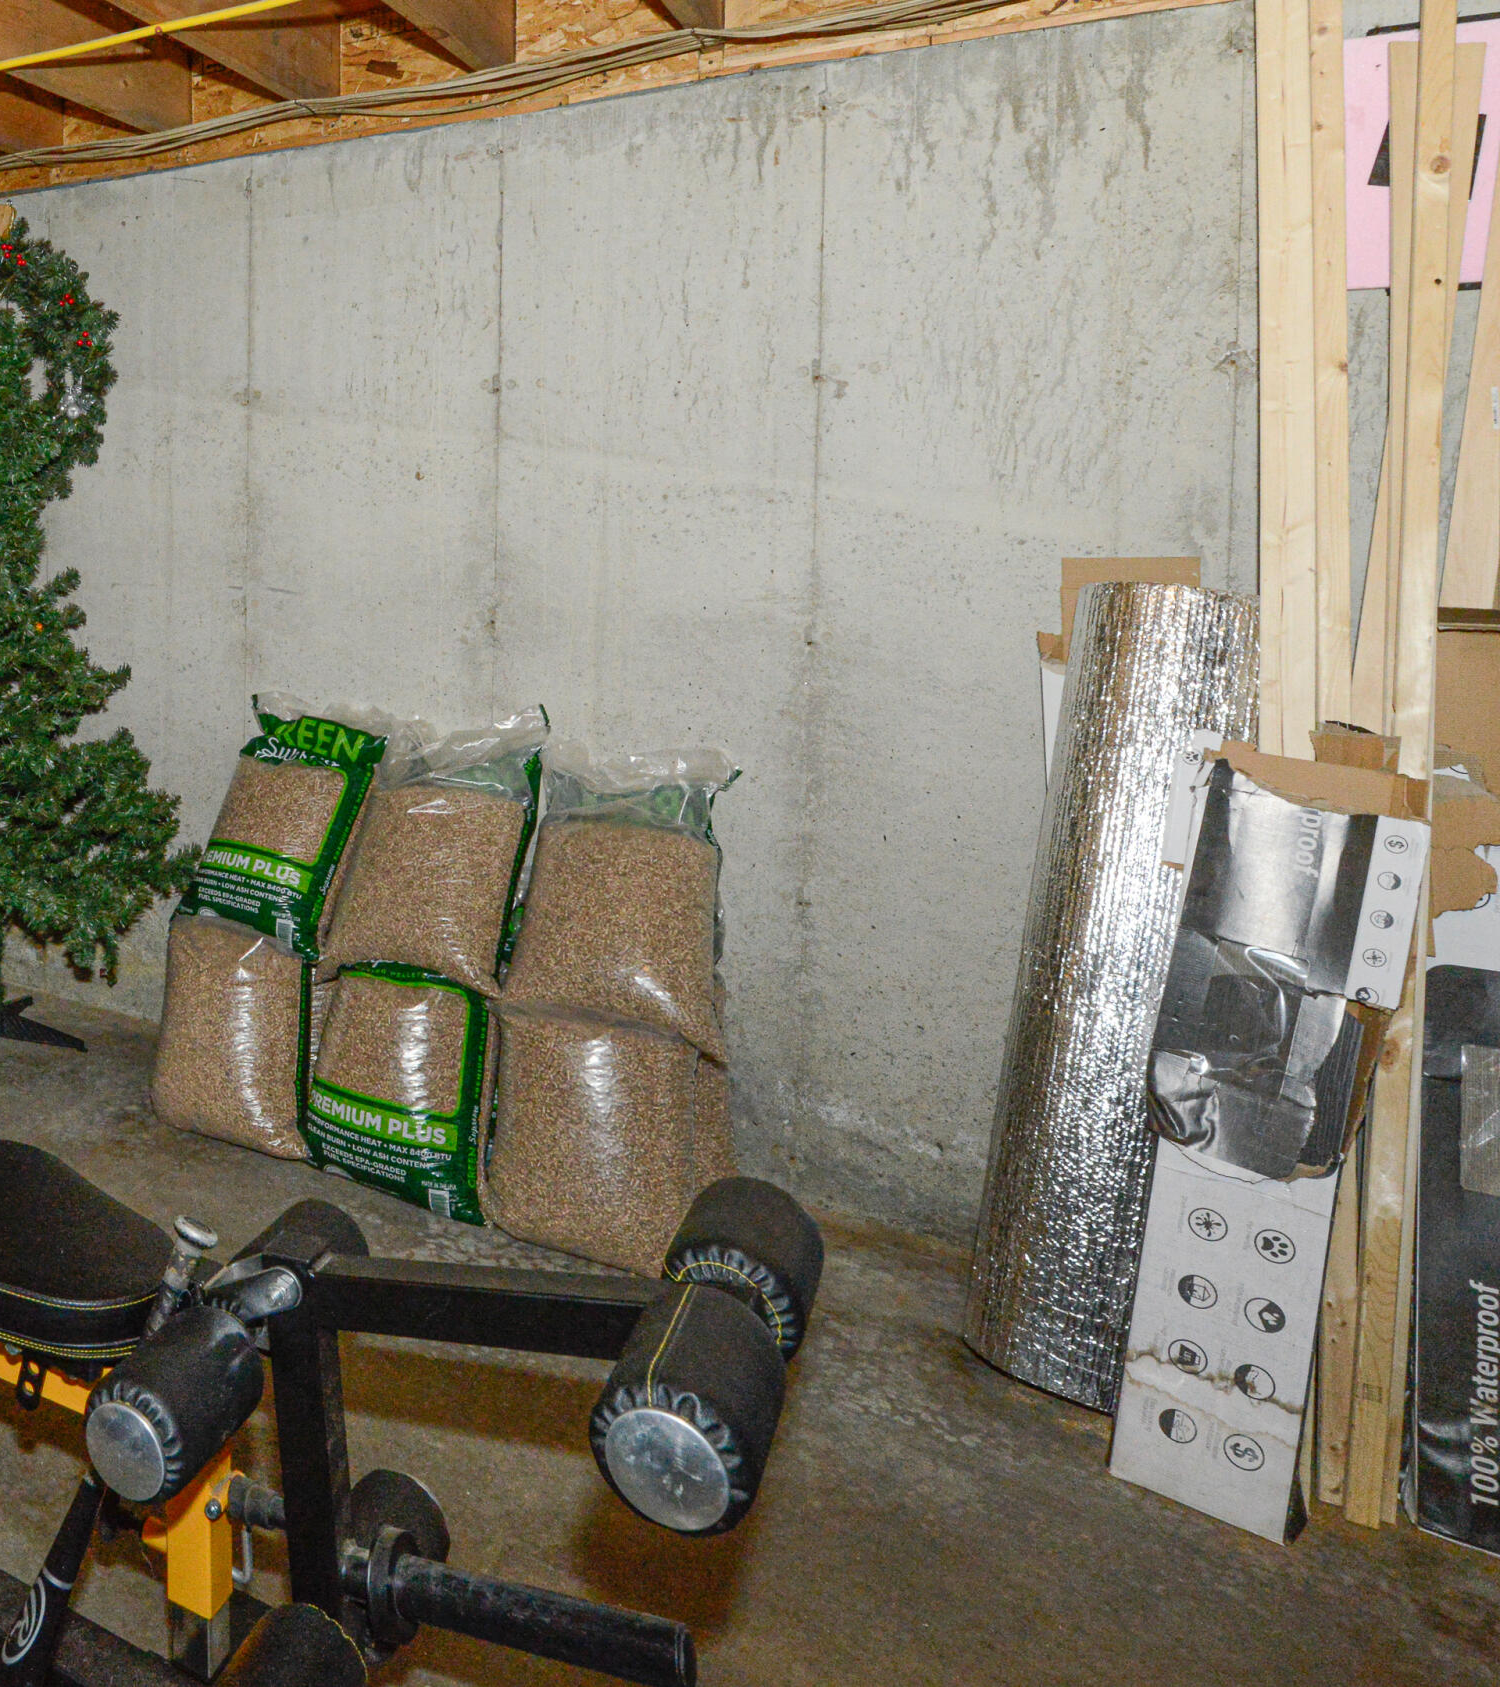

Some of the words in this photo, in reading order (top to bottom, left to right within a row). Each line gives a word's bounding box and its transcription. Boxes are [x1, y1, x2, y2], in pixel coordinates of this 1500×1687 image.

[1293, 810, 1323, 878] proof
[204, 850, 251, 870] EMIUM
[252, 858, 302, 886] PLUS
[198, 886, 222, 897] EXCEEDS
[222, 892, 261, 908] EPA-GRADED
[221, 881, 236, 890] LOW
[235, 886, 250, 894] ASH
[229, 873, 246, 883] HEAT
[250, 879, 267, 888] MAX
[267, 884, 286, 894] 8400
[286, 890, 302, 900] BTU
[198, 893, 211, 902] FUEL
[212, 896, 259, 914] SPECIFICATIONS
[360, 1135, 383, 1148] HEAT
[389, 1143, 408, 1154] MAX
[388, 1118, 447, 1145] PLUS
[322, 1142, 354, 1160] EXCEEDS
[355, 1155, 407, 1177] EPA-GRADED
[326, 1133, 347, 1147] BURN
[352, 1143, 371, 1156] LOW
[372, 1150, 389, 1161] ASH
[323, 1150, 341, 1162] FUEL
[342, 1158, 406, 1183] SPECIFICATIONS
[467, 1147, 478, 1188] GREEN
[1469, 1278, 1500, 1427] Waterproof
[1469, 1436, 1500, 1506] 100%
